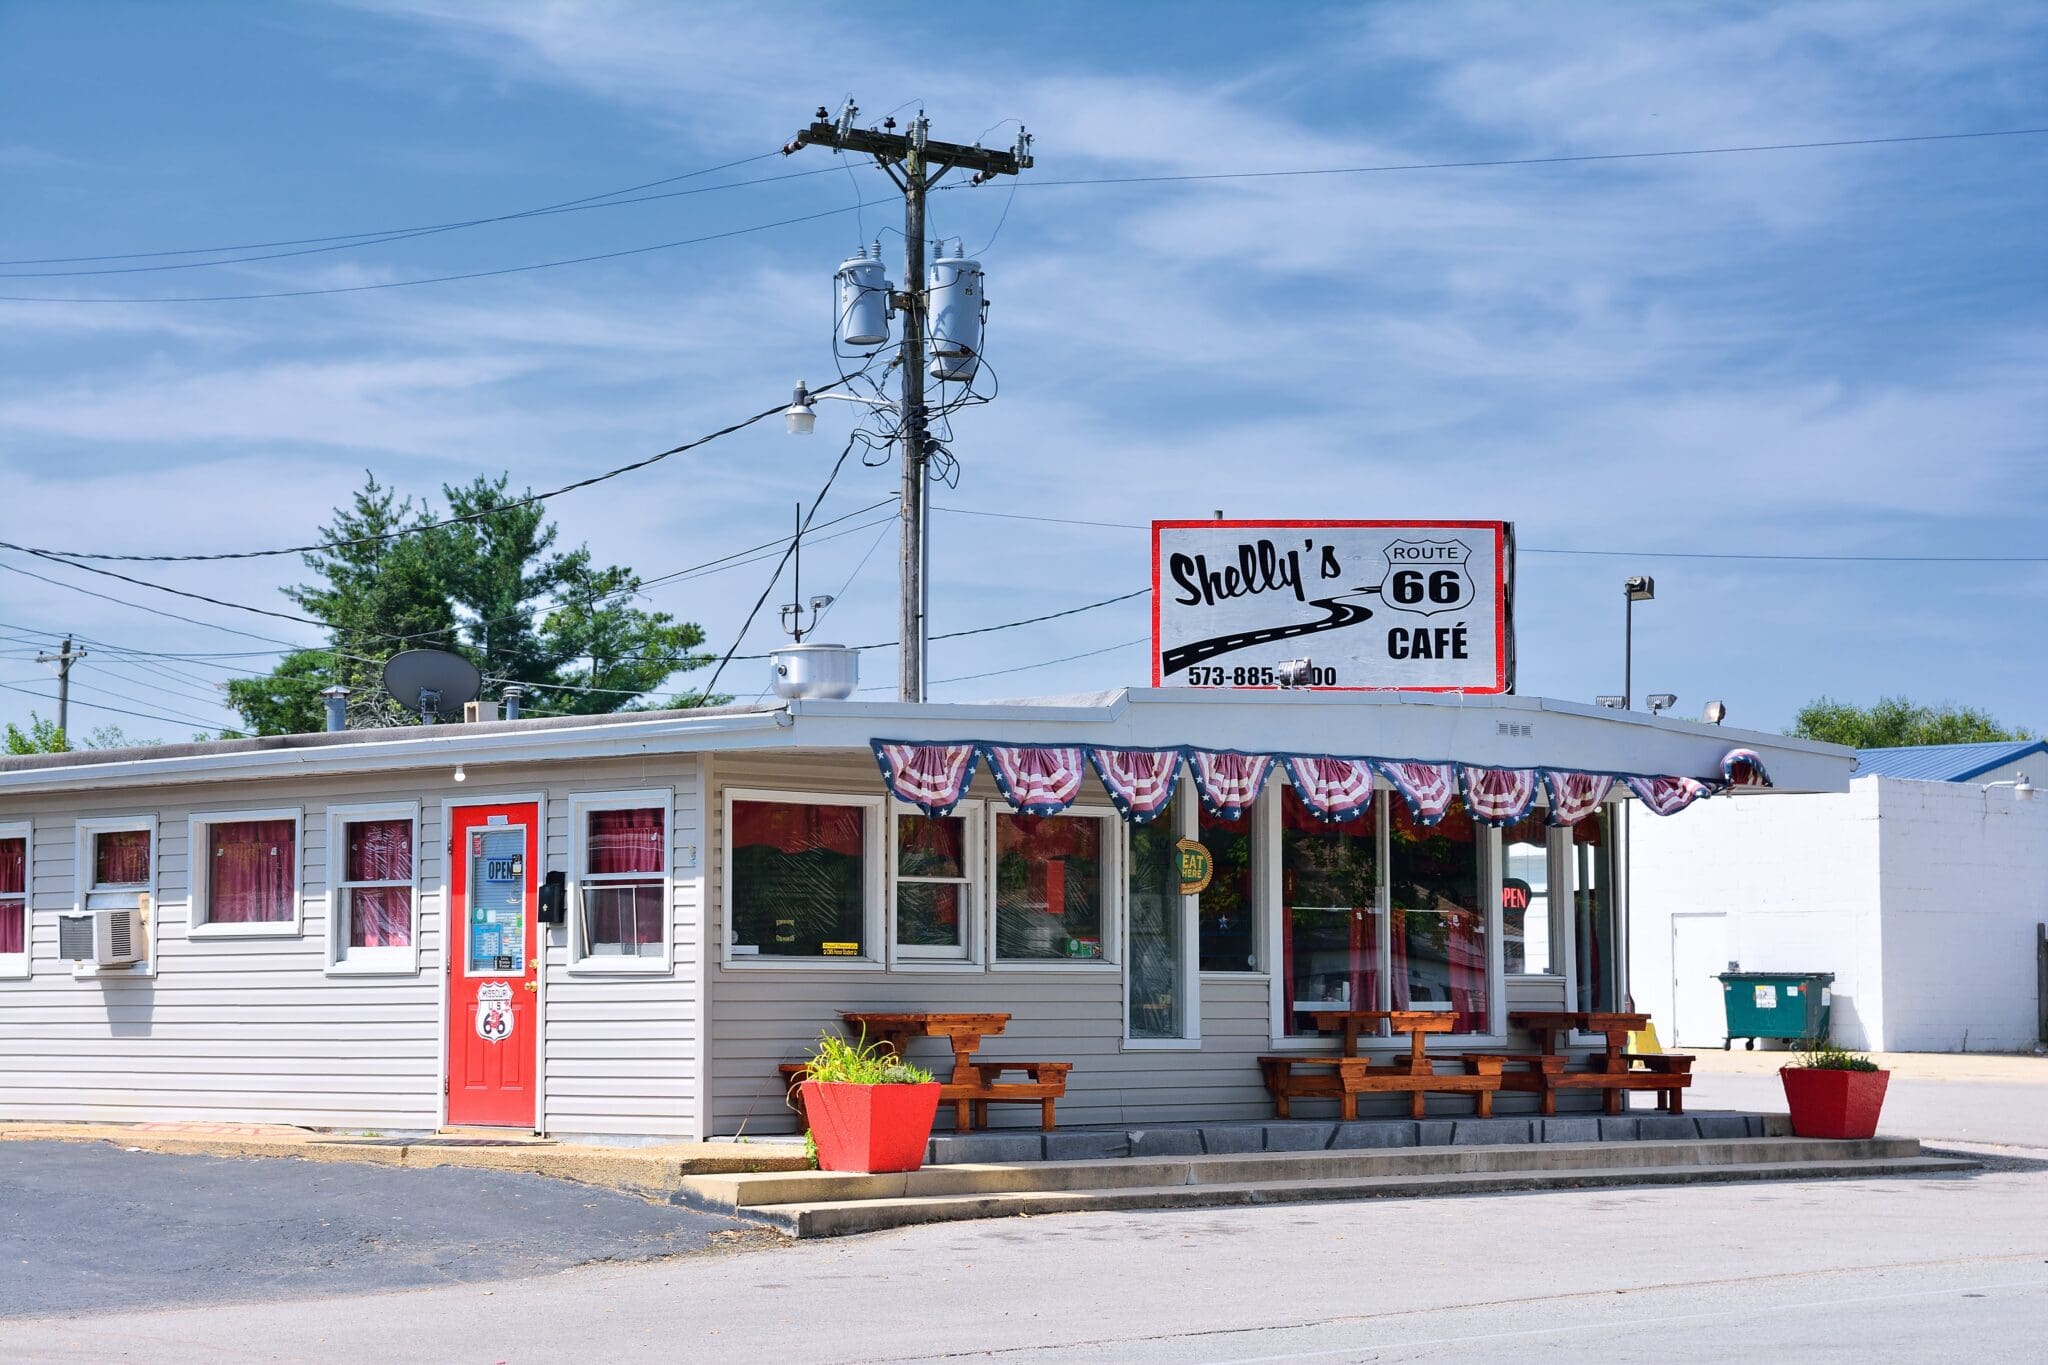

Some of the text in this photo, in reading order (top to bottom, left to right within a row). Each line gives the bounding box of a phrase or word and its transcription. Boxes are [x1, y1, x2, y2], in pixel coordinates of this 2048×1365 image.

[1393, 547, 1458, 559] ROUTE
[1170, 539, 1341, 606] Shelly's
[1393, 570, 1460, 604] 66
[1388, 622, 1468, 660] CAFÉ
[1188, 666, 1337, 686] 573-885-00
[488, 861, 513, 880] OPEN
[1182, 854, 1204, 869] EAT
[1182, 869, 1202, 878] HERE
[1501, 887, 1527, 909] PEN
